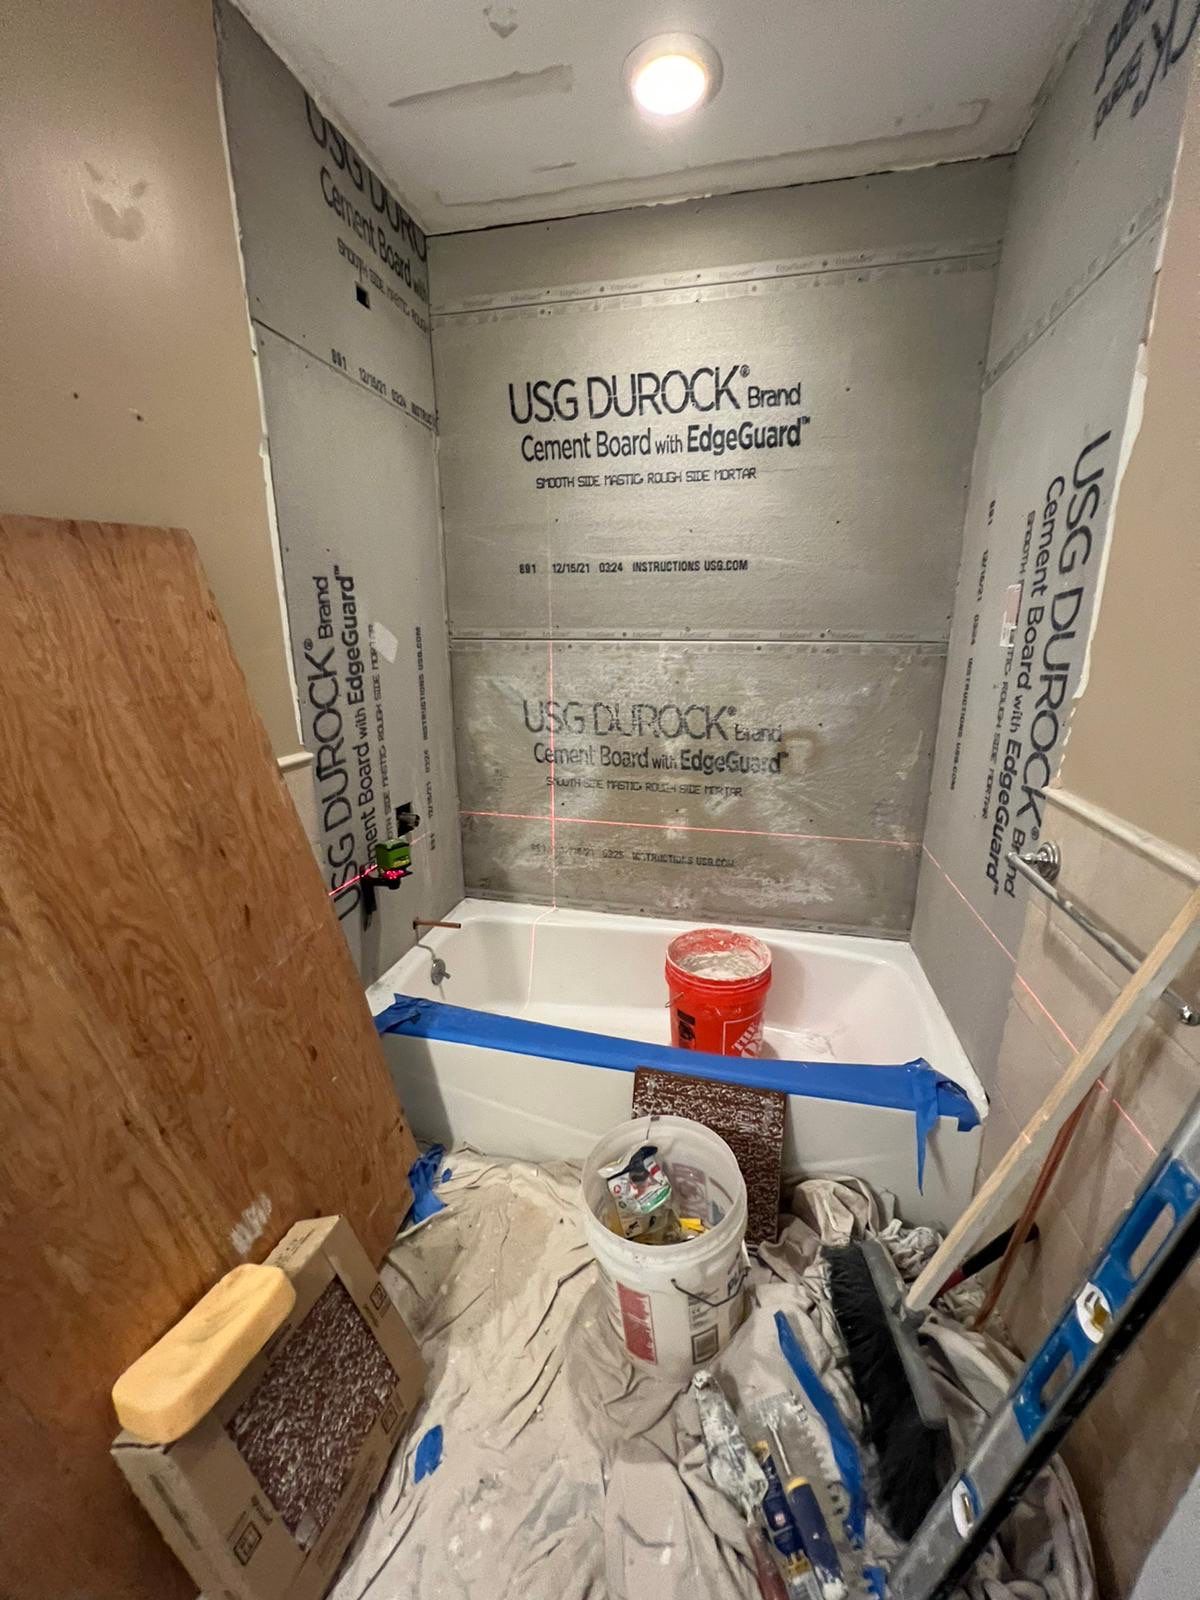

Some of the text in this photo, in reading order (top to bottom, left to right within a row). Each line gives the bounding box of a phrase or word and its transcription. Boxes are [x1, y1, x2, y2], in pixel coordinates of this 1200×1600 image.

[320, 166, 377, 254] Cement
[377, 226, 411, 288] Board
[509, 378, 578, 424] USG
[747, 382, 801, 408] Brand
[521, 432, 591, 462] Cement
[596, 427, 651, 458] Board
[654, 434, 683, 455] with
[535, 476, 574, 489] SMOOTH
[577, 474, 600, 487] SIDE
[647, 471, 682, 484] ROUGH
[686, 469, 710, 482] SIDE
[714, 467, 757, 481] MORTAR
[1058, 430, 1111, 575] USG
[1030, 476, 1065, 599] Cement
[599, 561, 623, 573] 0324
[632, 560, 700, 573] INSTRUCTIONS
[704, 559, 748, 571] USG.COM
[312, 576, 333, 639] Brand
[1017, 606, 1044, 691] Board
[355, 706, 368, 739] with
[522, 699, 587, 735] USG
[735, 723, 782, 742] Brand
[1009, 694, 1024, 733] with
[352, 741, 374, 807] Board
[533, 742, 595, 766] Cement
[599, 745, 649, 769] Board
[651, 752, 678, 770] with
[328, 833, 362, 920] USG
[1004, 827, 1026, 898] Brnd
